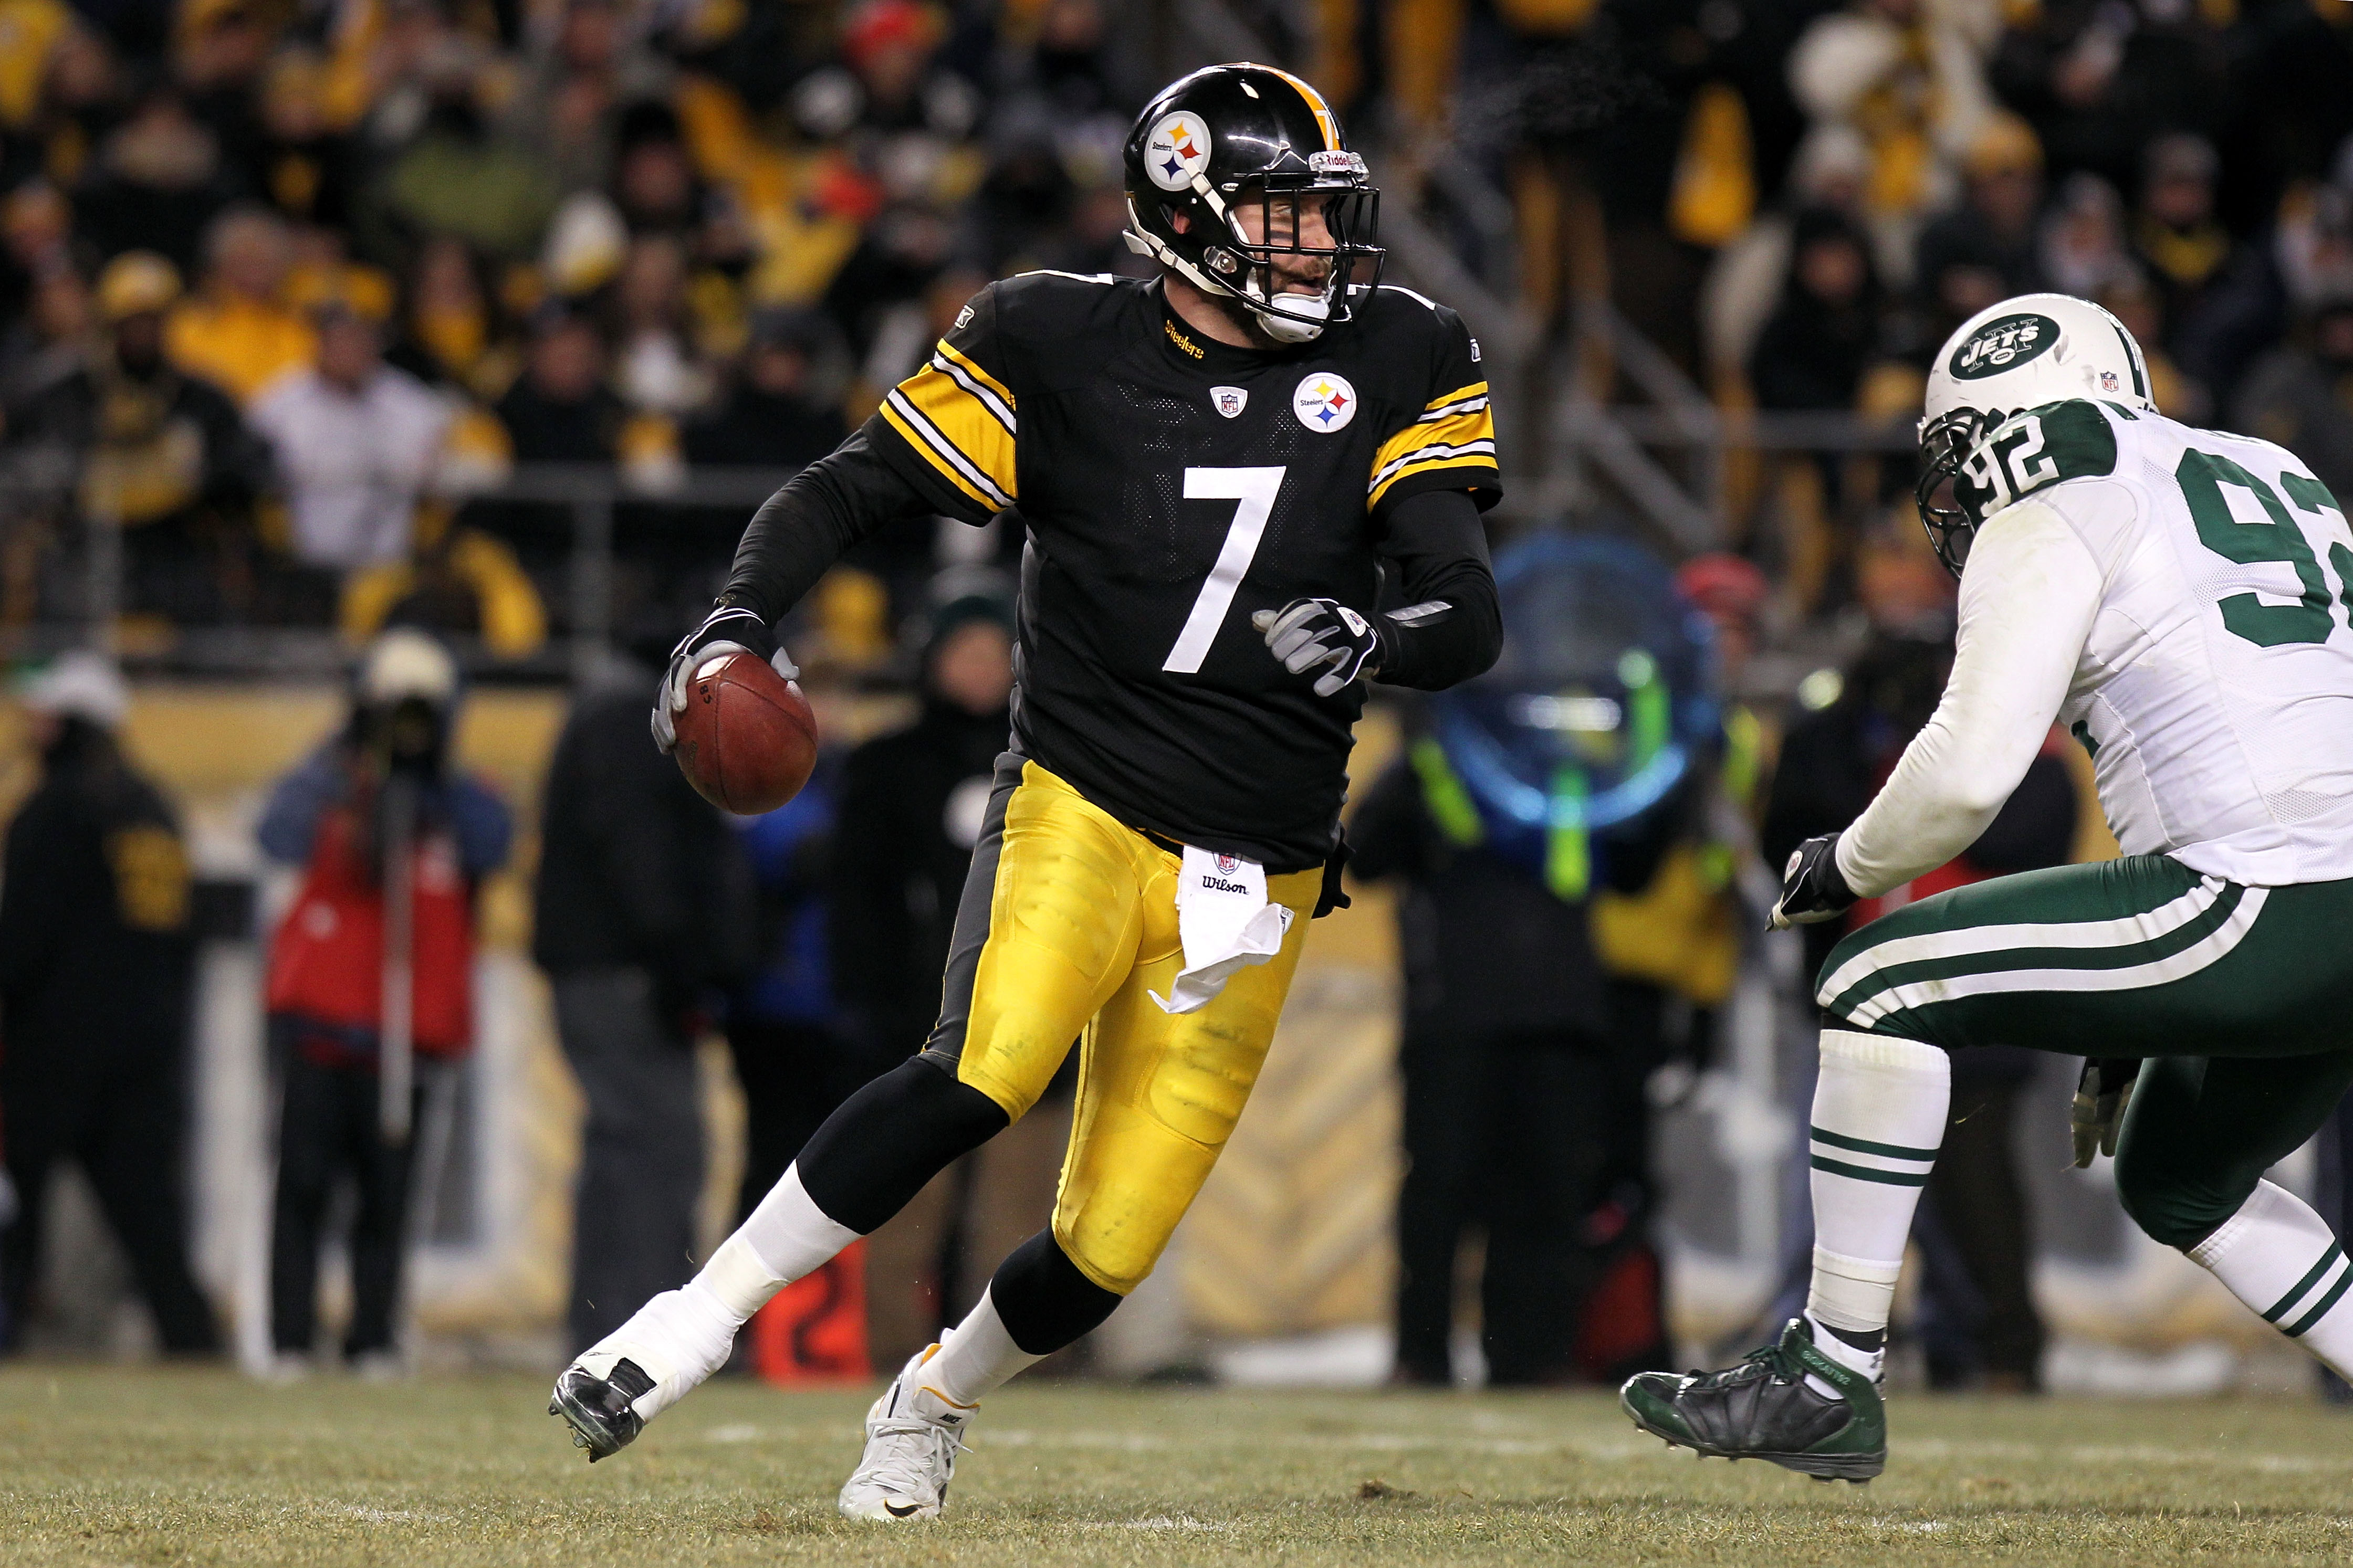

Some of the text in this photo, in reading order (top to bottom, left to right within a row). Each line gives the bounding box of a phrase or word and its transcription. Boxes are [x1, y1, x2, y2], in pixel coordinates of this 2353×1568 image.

[1152, 142, 1173, 151] Steelers
[1165, 319, 1204, 359] Steelers
[1961, 325, 2040, 367] JETS
[2103, 379, 2118, 391] NFL
[1222, 402, 1238, 412] NFL
[1962, 415, 2059, 518] 92
[1162, 466, 1287, 673] 7
[1219, 855, 1235, 869] NFL
[1202, 875, 1249, 896] Wilson
[939, 1413, 963, 1425] NIKE
